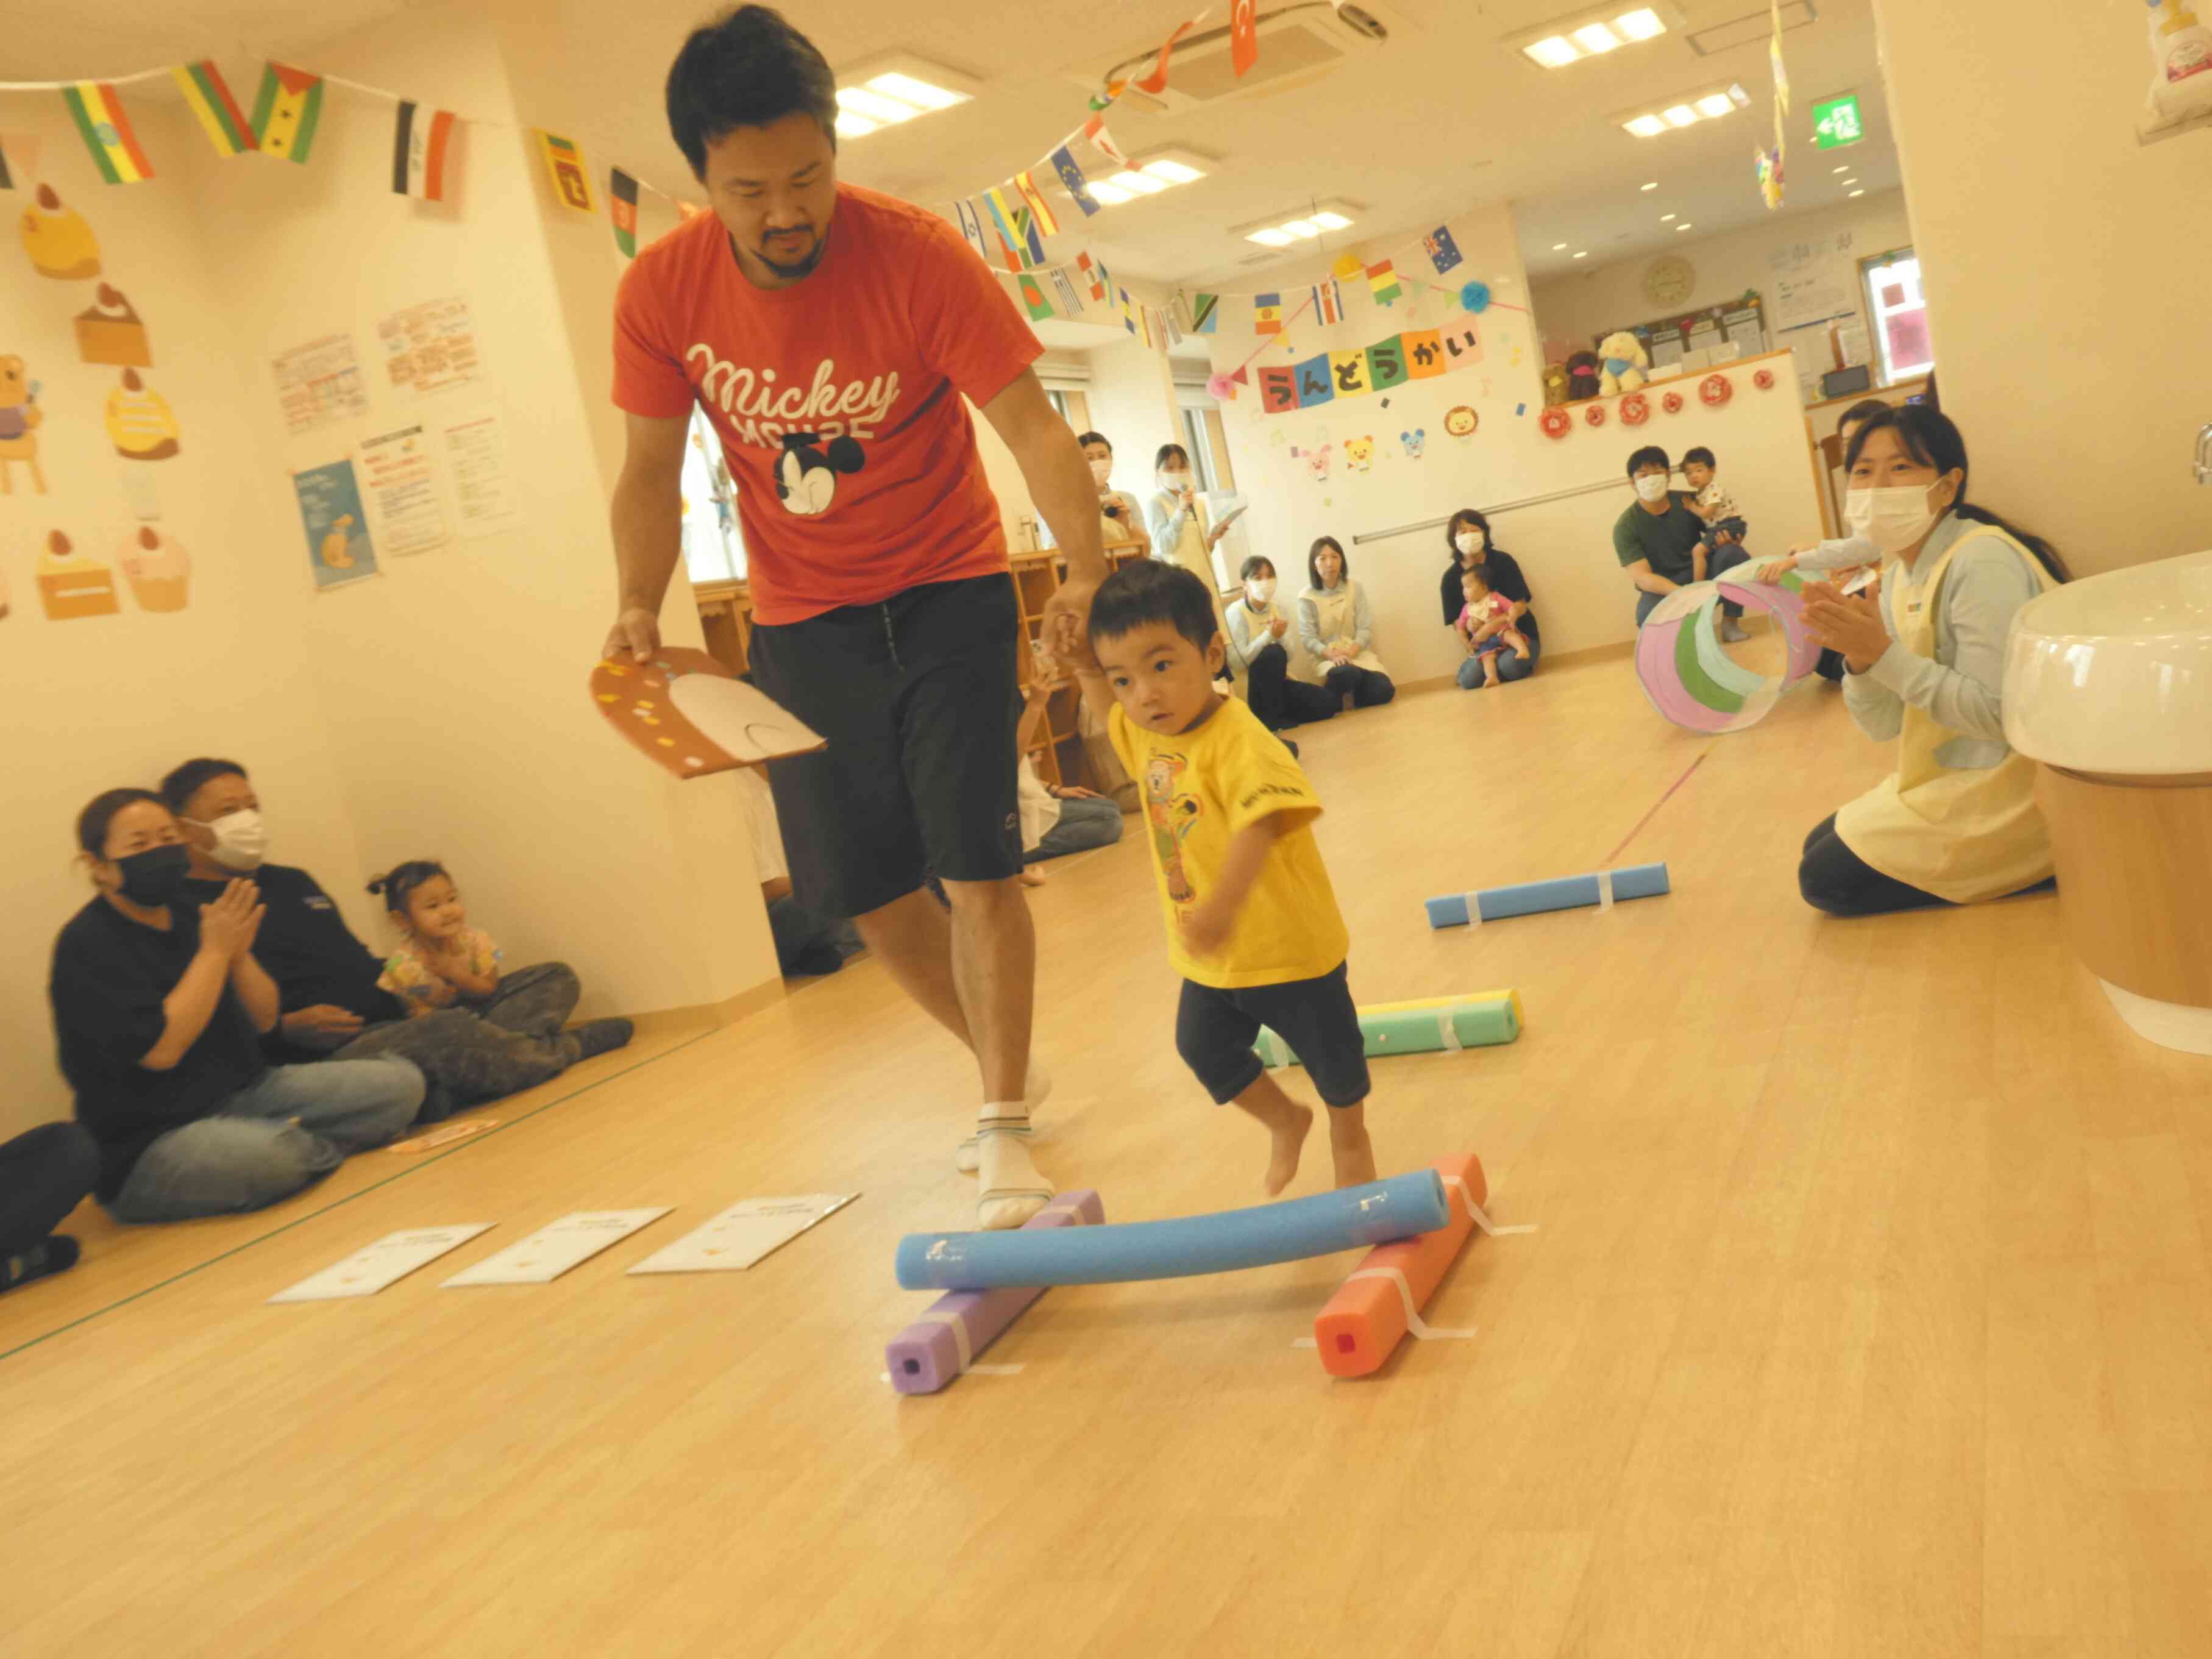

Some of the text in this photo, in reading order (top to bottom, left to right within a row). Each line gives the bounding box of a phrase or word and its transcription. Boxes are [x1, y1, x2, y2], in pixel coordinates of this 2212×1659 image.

[686, 343, 900, 424] Mickey
[1267, 330, 1476, 405] うんどうかい
